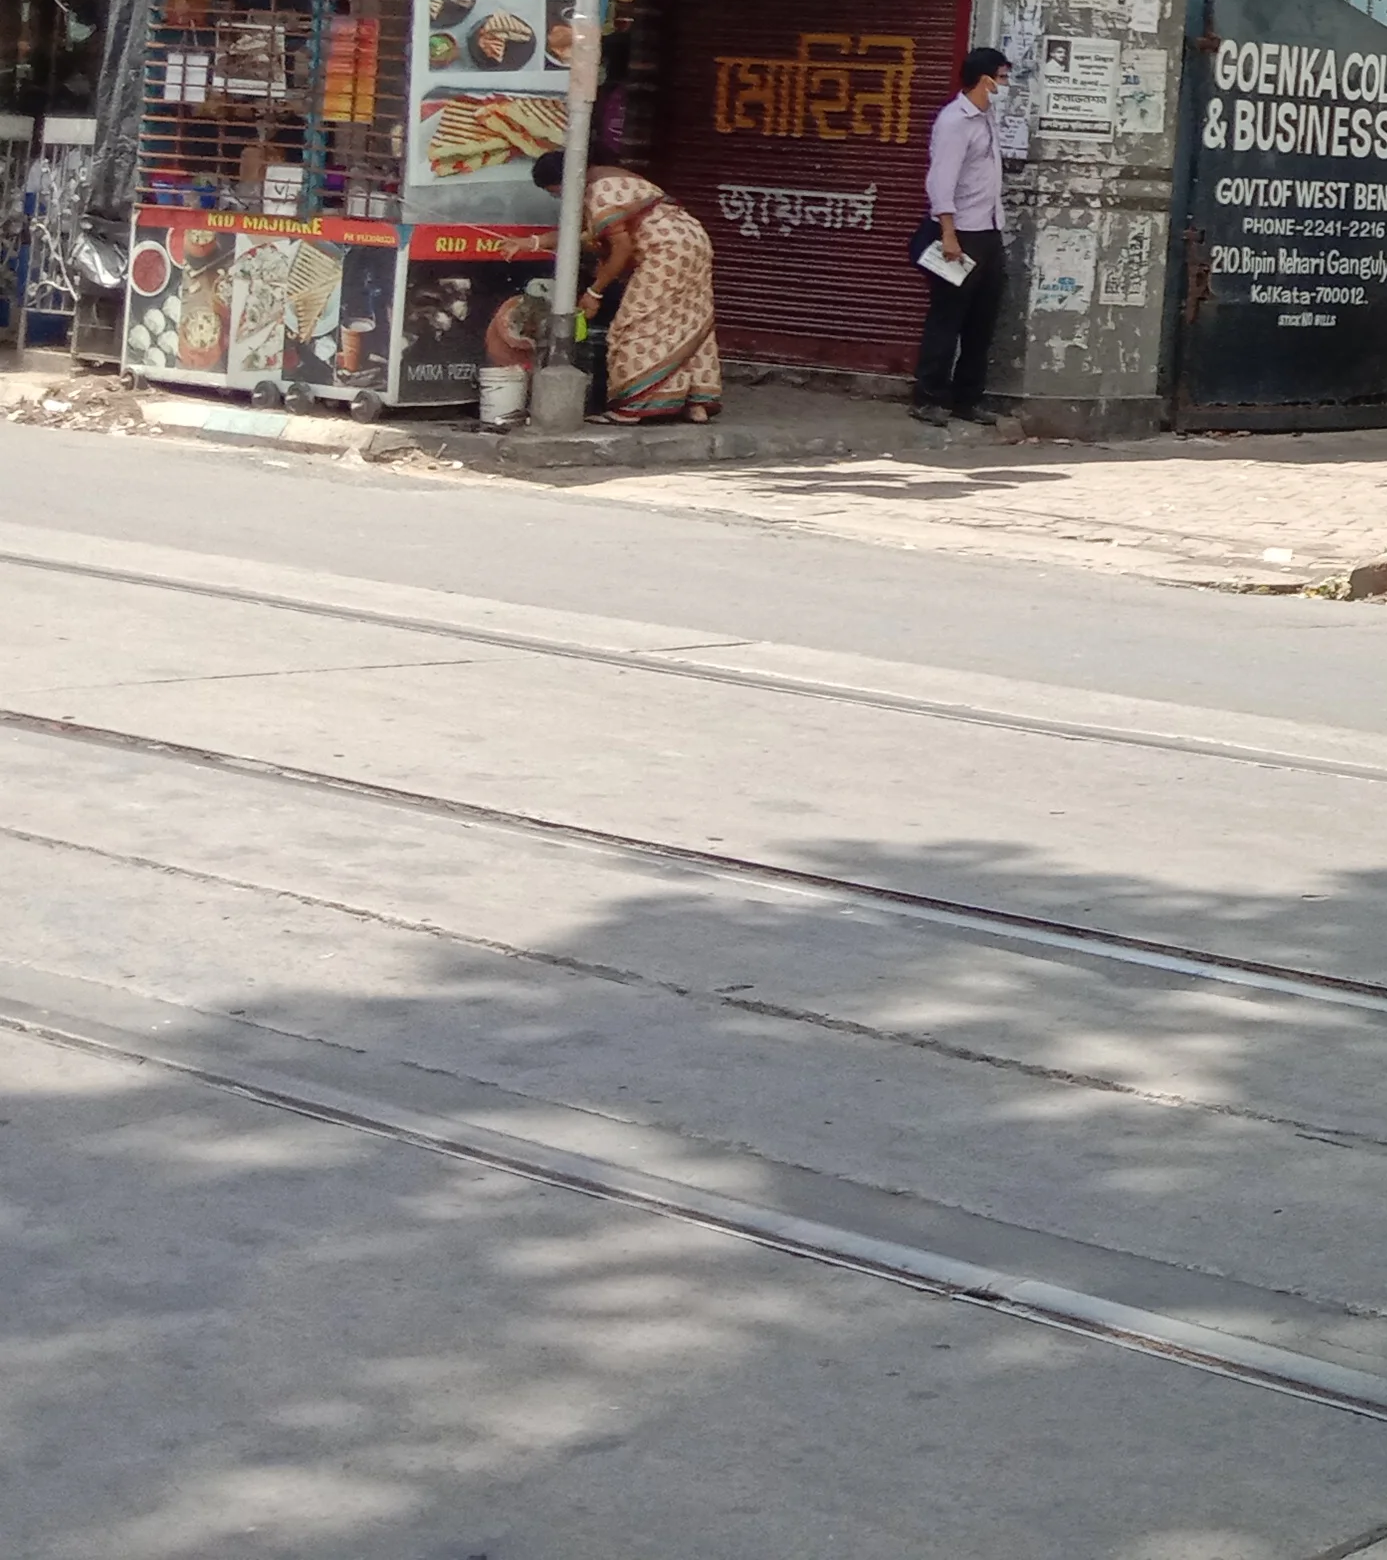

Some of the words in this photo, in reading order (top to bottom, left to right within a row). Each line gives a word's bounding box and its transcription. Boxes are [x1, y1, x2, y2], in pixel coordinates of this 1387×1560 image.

[1214, 39, 1338, 101] GOENKA
[714, 32, 918, 146] মোহিনী
[1202, 97, 1228, 150] &
[716, 182, 879, 238] জুয়েলার্স
[1294, 180, 1350, 210] WEST
[1243, 217, 1386, 239] PHONE-2241-2216
[1278, 248, 1325, 276] Behari
[1314, 314, 1337, 327] BILLS
[408, 363, 444, 381] MATKA
[447, 363, 479, 381] PIZZA
